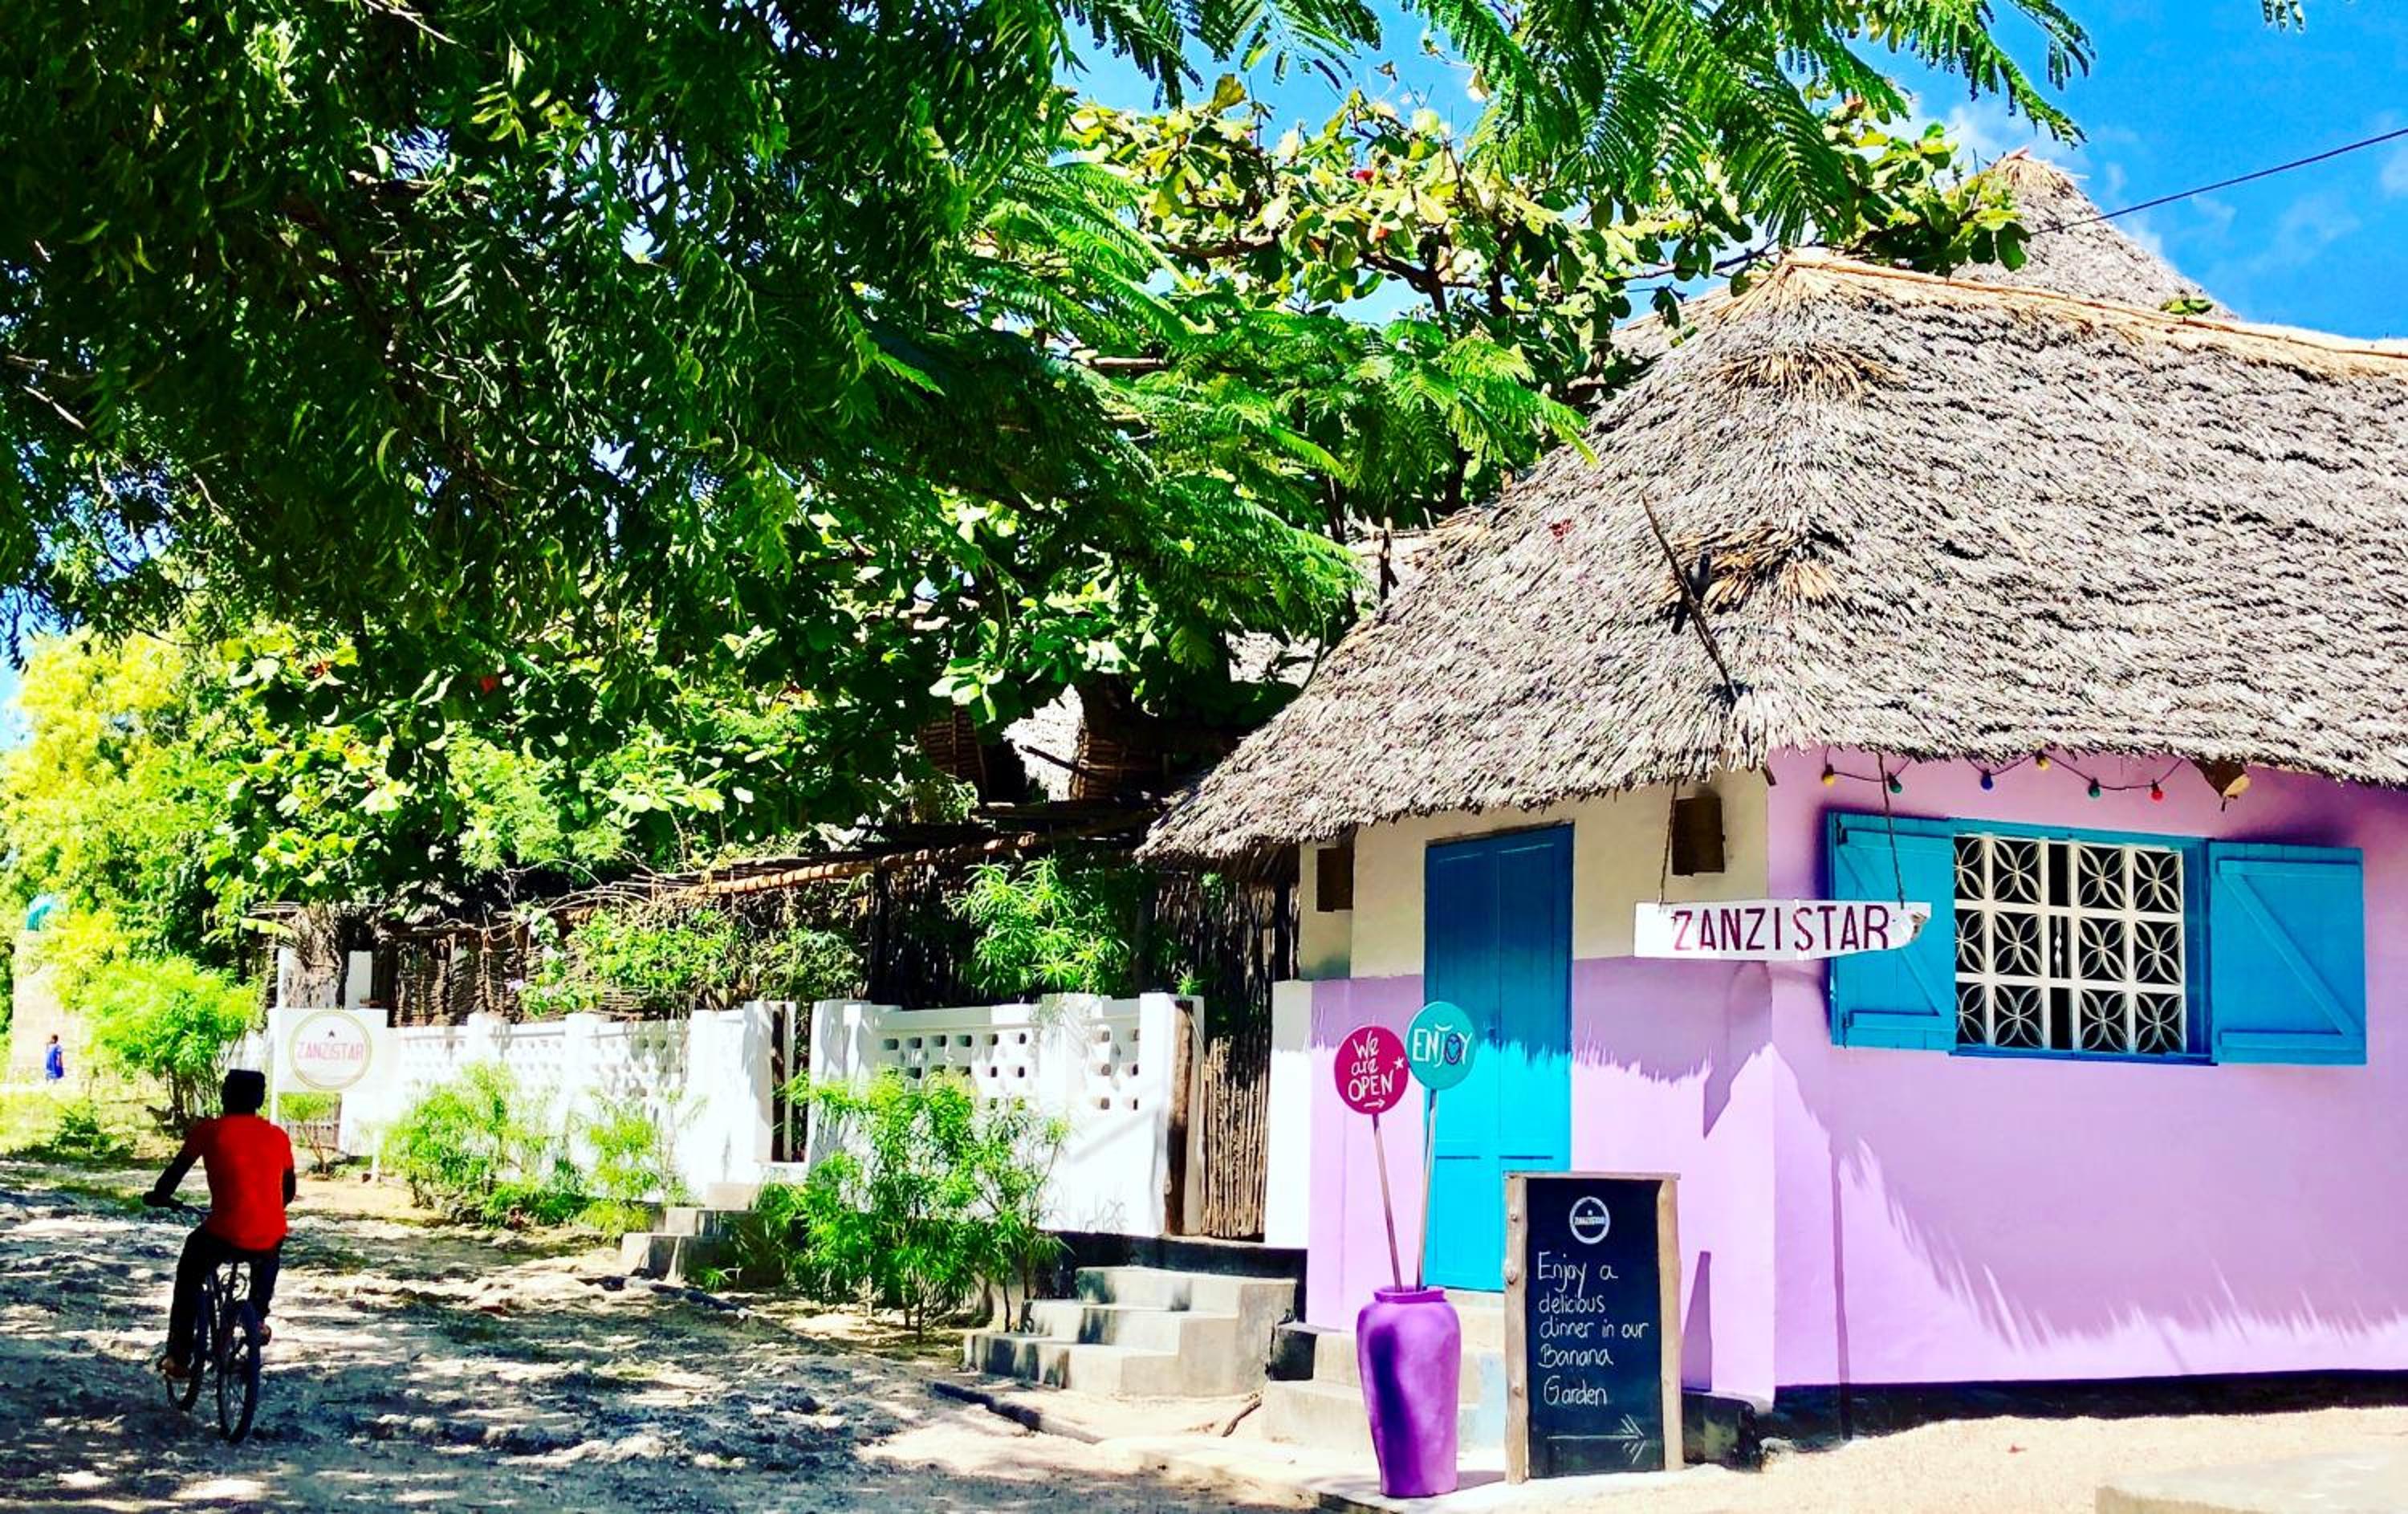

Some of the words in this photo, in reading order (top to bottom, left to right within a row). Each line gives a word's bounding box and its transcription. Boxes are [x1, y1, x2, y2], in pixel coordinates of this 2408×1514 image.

[1673, 904, 1889, 951] ZANZISTAR
[296, 1041, 364, 1060] ZANZISTAR
[1352, 1030, 1379, 1060] We
[1413, 1024, 1473, 1068] ENJOY
[1351, 1058, 1379, 1076] are
[1348, 1069, 1394, 1101] OPEN
[1537, 1251, 1587, 1299] Enjoy
[1600, 1264, 1619, 1280] a
[1539, 1290, 1606, 1314] delicious
[1540, 1315, 1595, 1339] dinner
[1601, 1318, 1615, 1337] in
[1621, 1322, 1649, 1339] our
[1538, 1343, 1614, 1369] Banana
[1544, 1375, 1608, 1406] Garden
